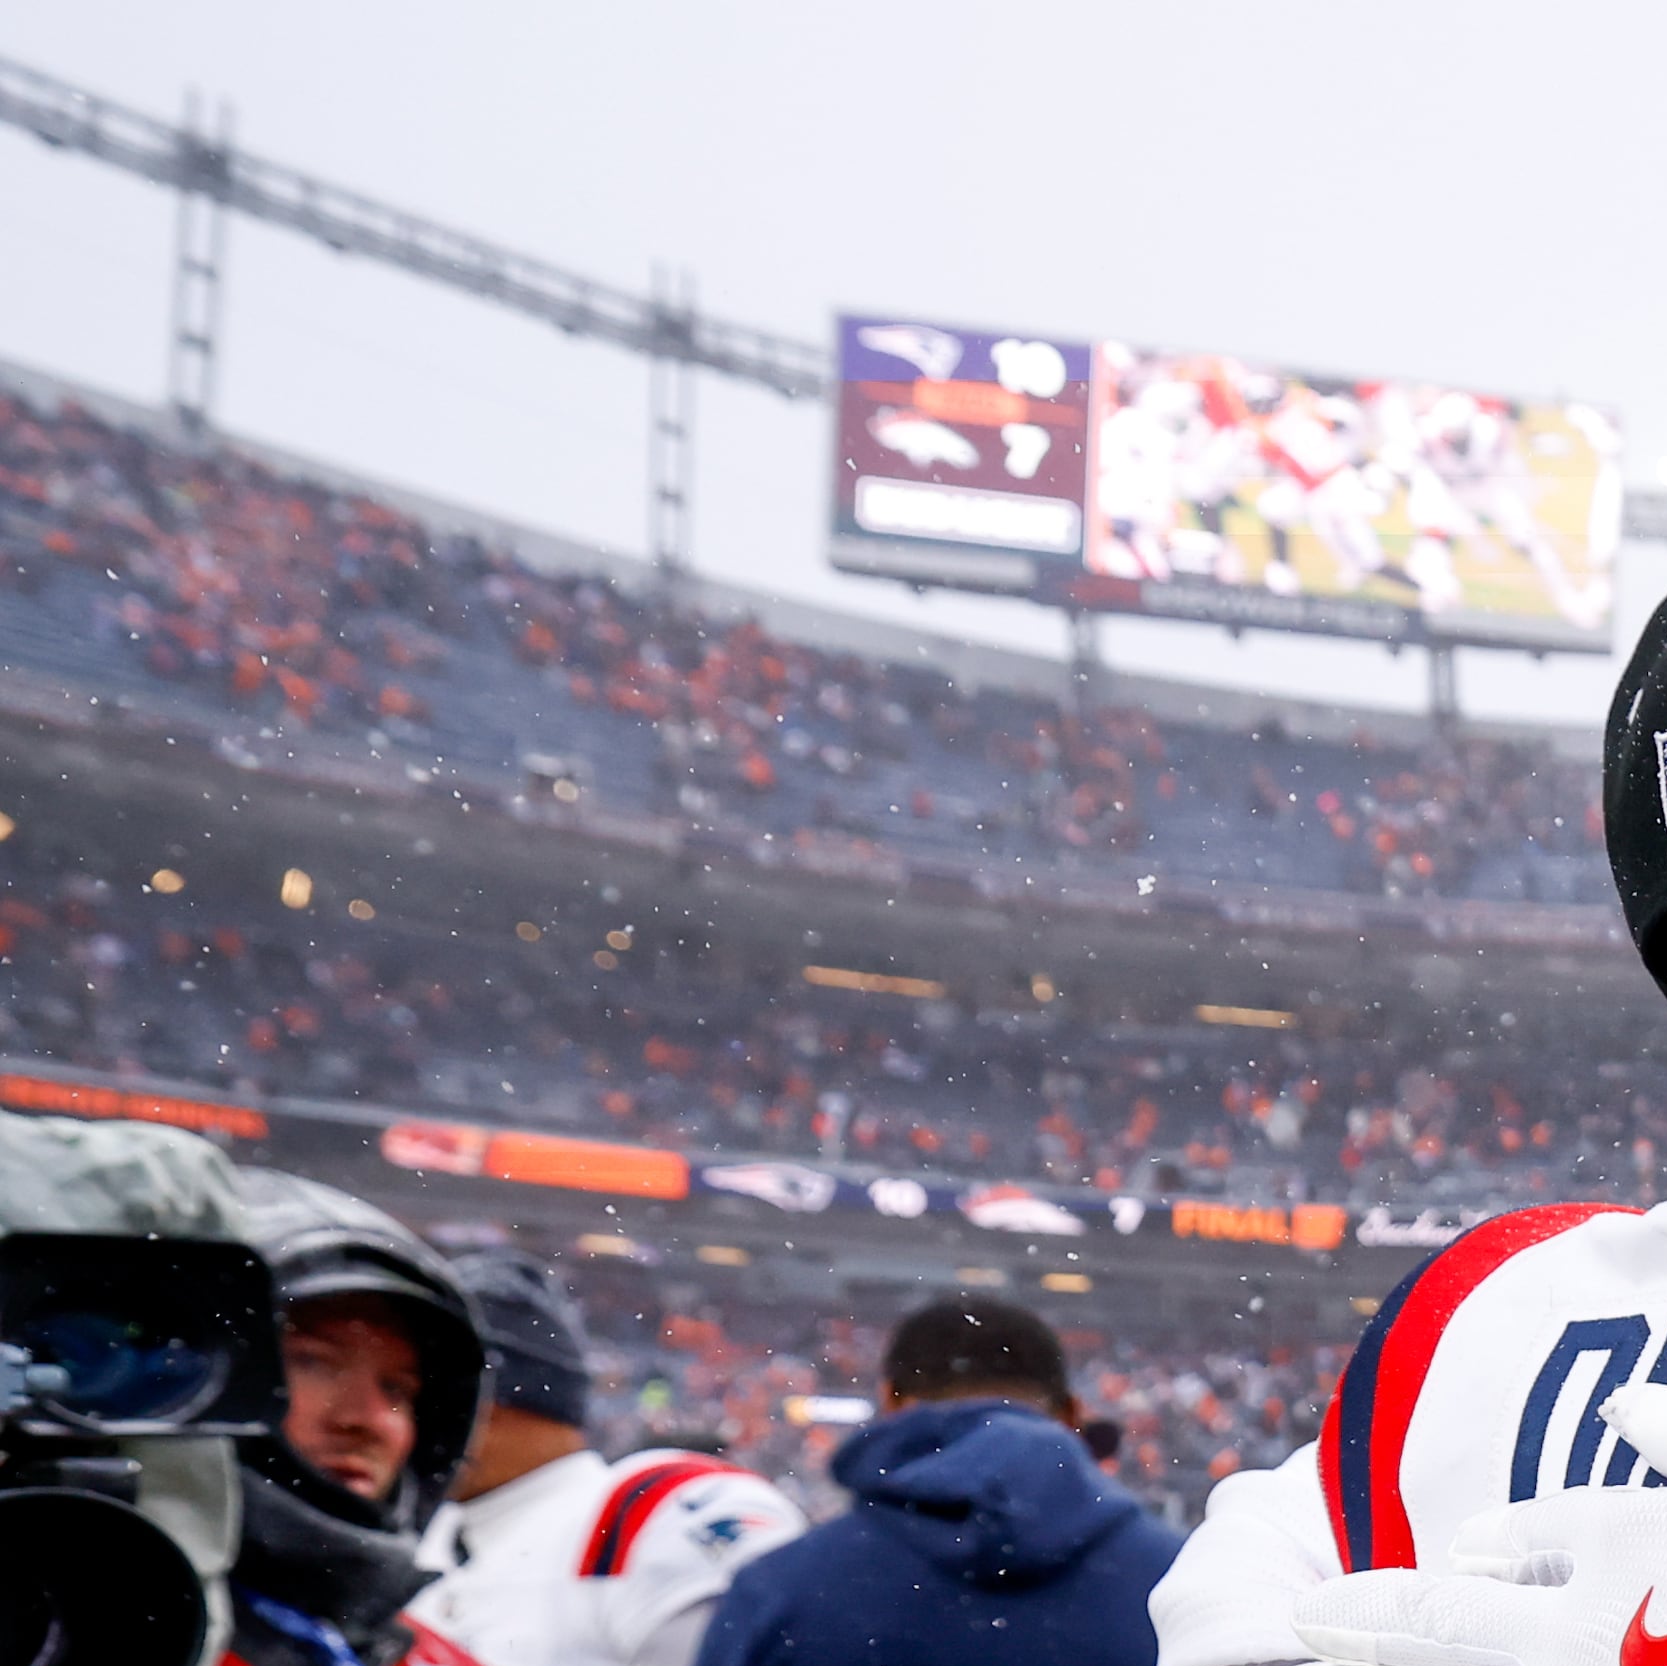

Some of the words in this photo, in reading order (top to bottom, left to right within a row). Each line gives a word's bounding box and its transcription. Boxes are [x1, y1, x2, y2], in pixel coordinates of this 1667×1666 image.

[867, 1177, 928, 1219] 10
[1108, 1196, 1146, 1235] 7
[1171, 1198, 1290, 1246] FINAL
